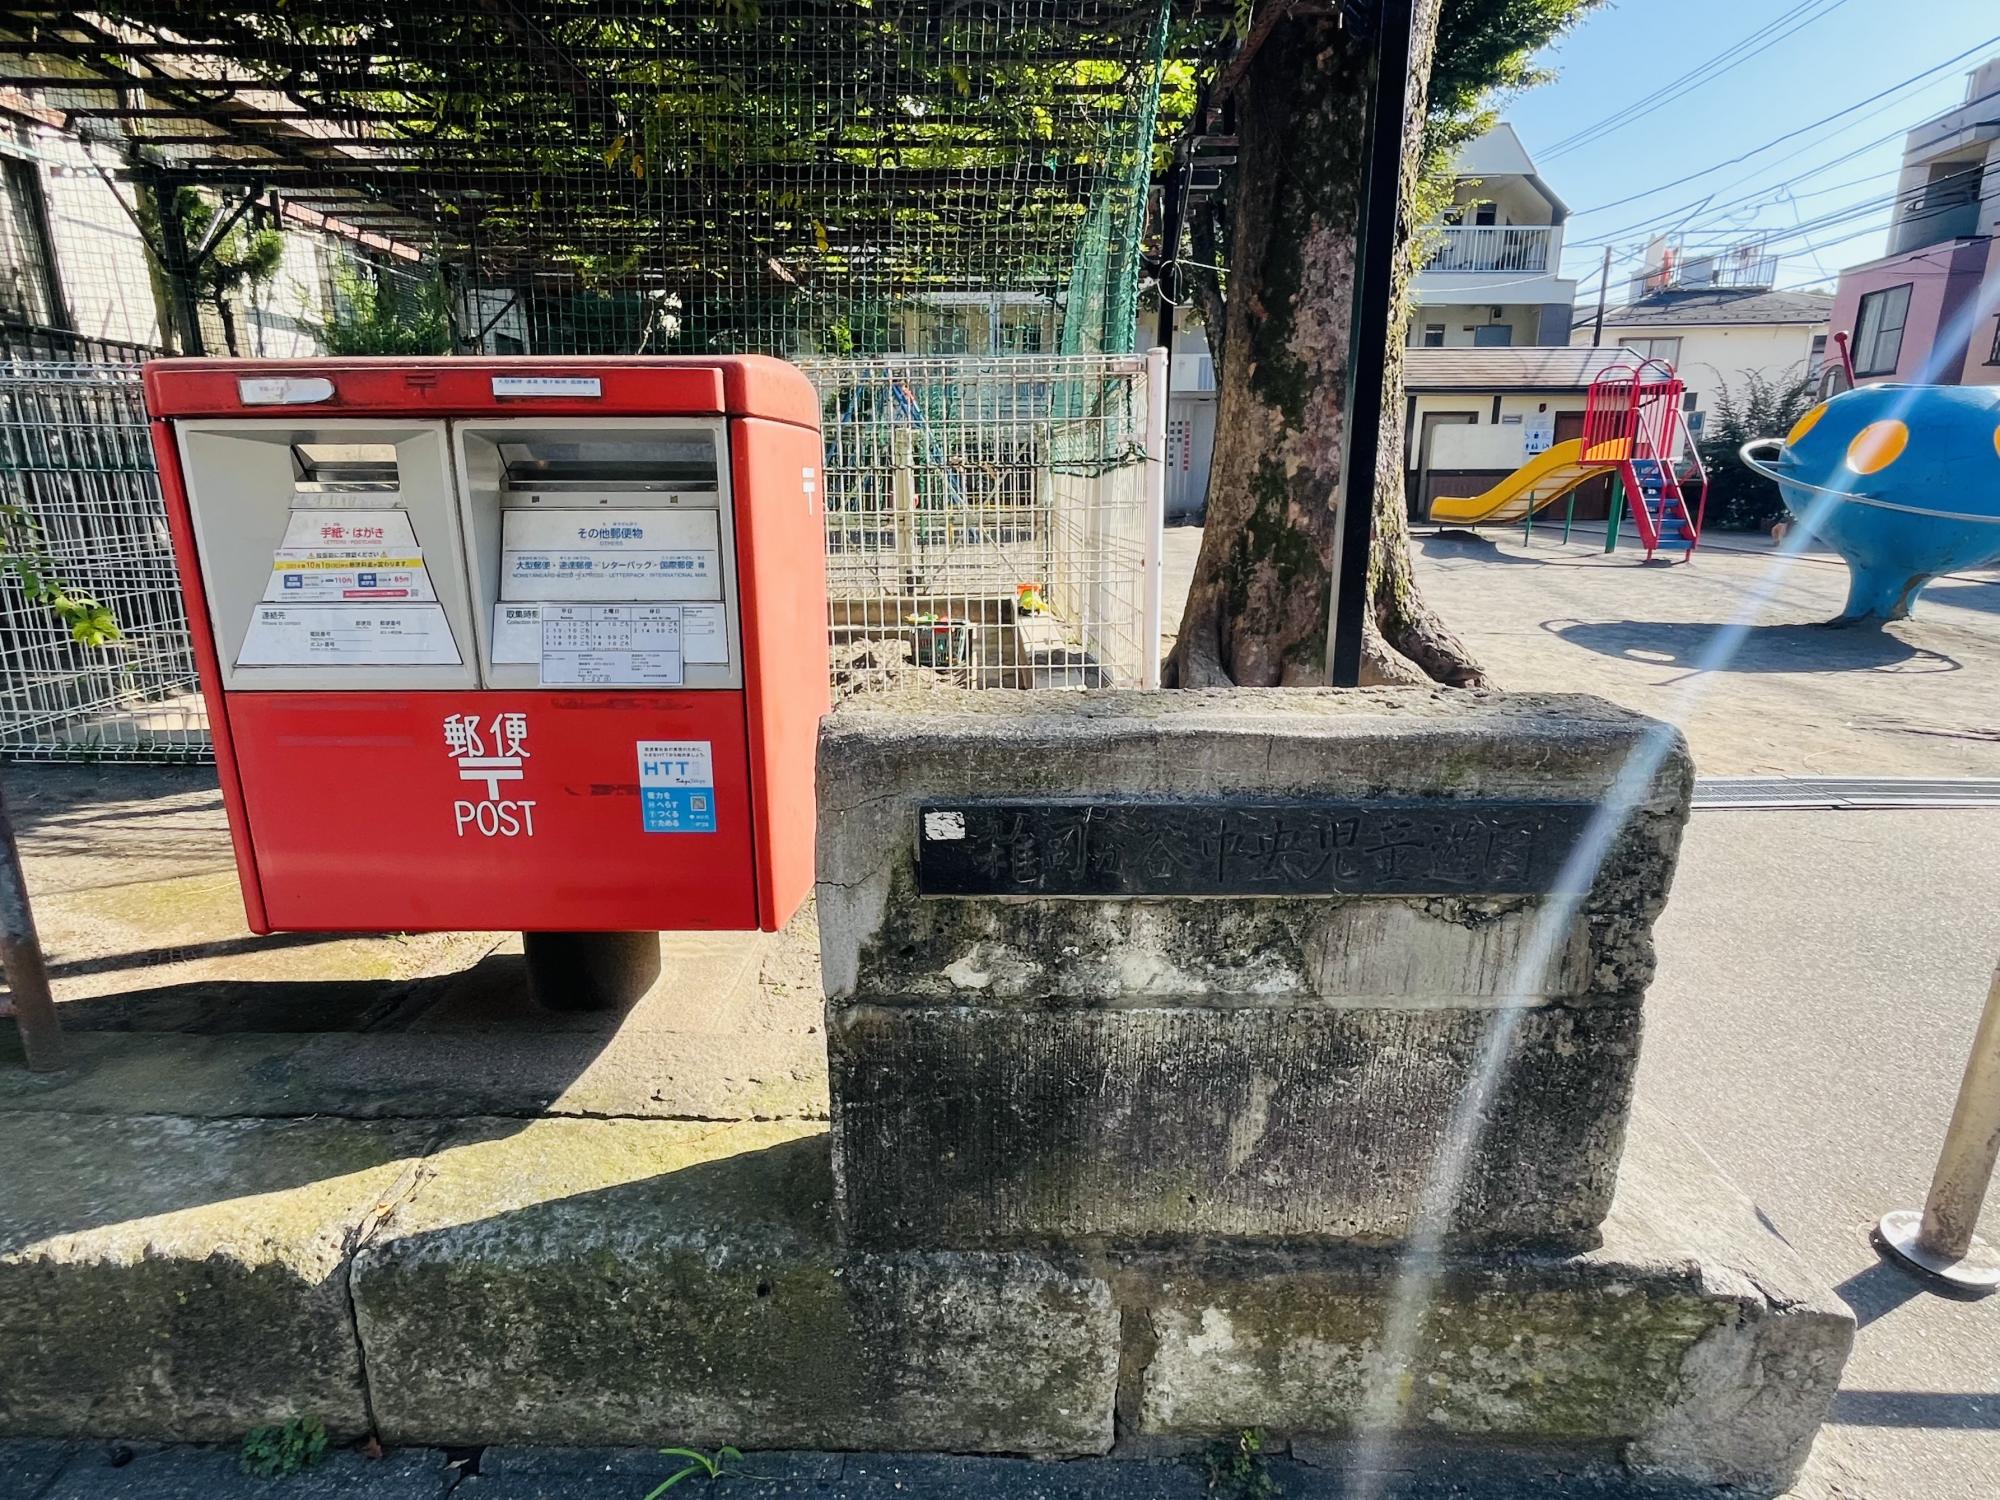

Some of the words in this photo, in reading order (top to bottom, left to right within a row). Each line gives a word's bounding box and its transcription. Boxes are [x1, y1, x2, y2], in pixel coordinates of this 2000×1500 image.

[321, 527, 384, 538] 手紙・はがき
[578, 528, 644, 539] その他郵便物
[443, 712, 530, 758] 郵便
[644, 762, 689, 776] HTT
[453, 800, 537, 837] POST
